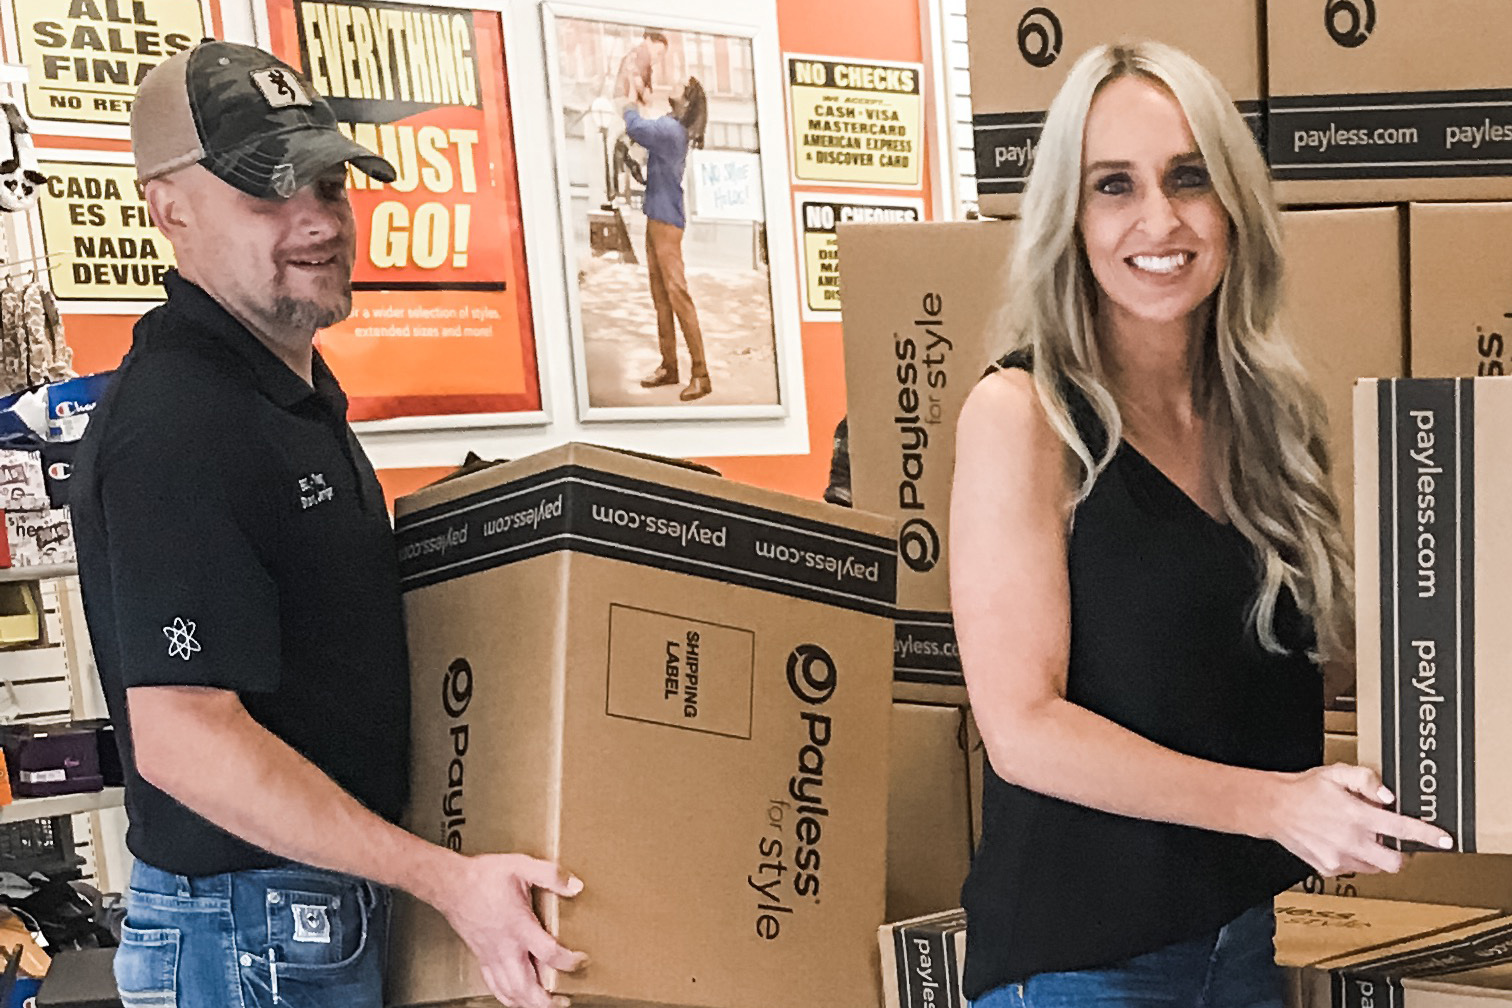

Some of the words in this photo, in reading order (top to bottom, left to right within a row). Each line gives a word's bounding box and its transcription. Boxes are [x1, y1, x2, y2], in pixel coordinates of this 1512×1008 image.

[67, 0, 157, 26] ALL
[33, 21, 191, 56] SALES
[301, 2, 478, 107] EVERYTHING
[795, 61, 827, 86] NO
[833, 64, 915, 92] CHECKS
[50, 95, 82, 110] NO
[814, 104, 855, 118] CASH
[865, 108, 899, 121] VISA
[803, 133, 861, 149] AMERICAN
[866, 137, 912, 153] EXPRESS
[808, 119, 906, 137] MASTERCARD
[1294, 123, 1418, 152] payless.com
[337, 122, 479, 193] MUST
[816, 150, 873, 166] DISCOVER
[879, 154, 909, 168] CARD
[47, 175, 122, 200] CADA
[69, 203, 106, 226] ES
[806, 205, 834, 230] NO
[73, 236, 158, 259] NADA
[369, 201, 471, 269] GO!
[408, 306, 457, 320] selection
[354, 325, 410, 337] extended
[442, 326, 462, 337] and
[915, 291, 953, 388] style
[894, 337, 929, 510] Payless
[925, 395, 941, 426] for
[484, 494, 563, 537] payless.com
[1409, 409, 1443, 598] payless.com
[592, 504, 727, 547] payless.com
[756, 541, 879, 581] payless.com
[664, 641, 680, 700] LABEL
[684, 630, 700, 718] SHIPPING
[1411, 640, 1444, 822] payless.com
[443, 724, 470, 852] Payle
[789, 711, 832, 898] Payless
[767, 799, 791, 833] for
[748, 836, 794, 940] style
